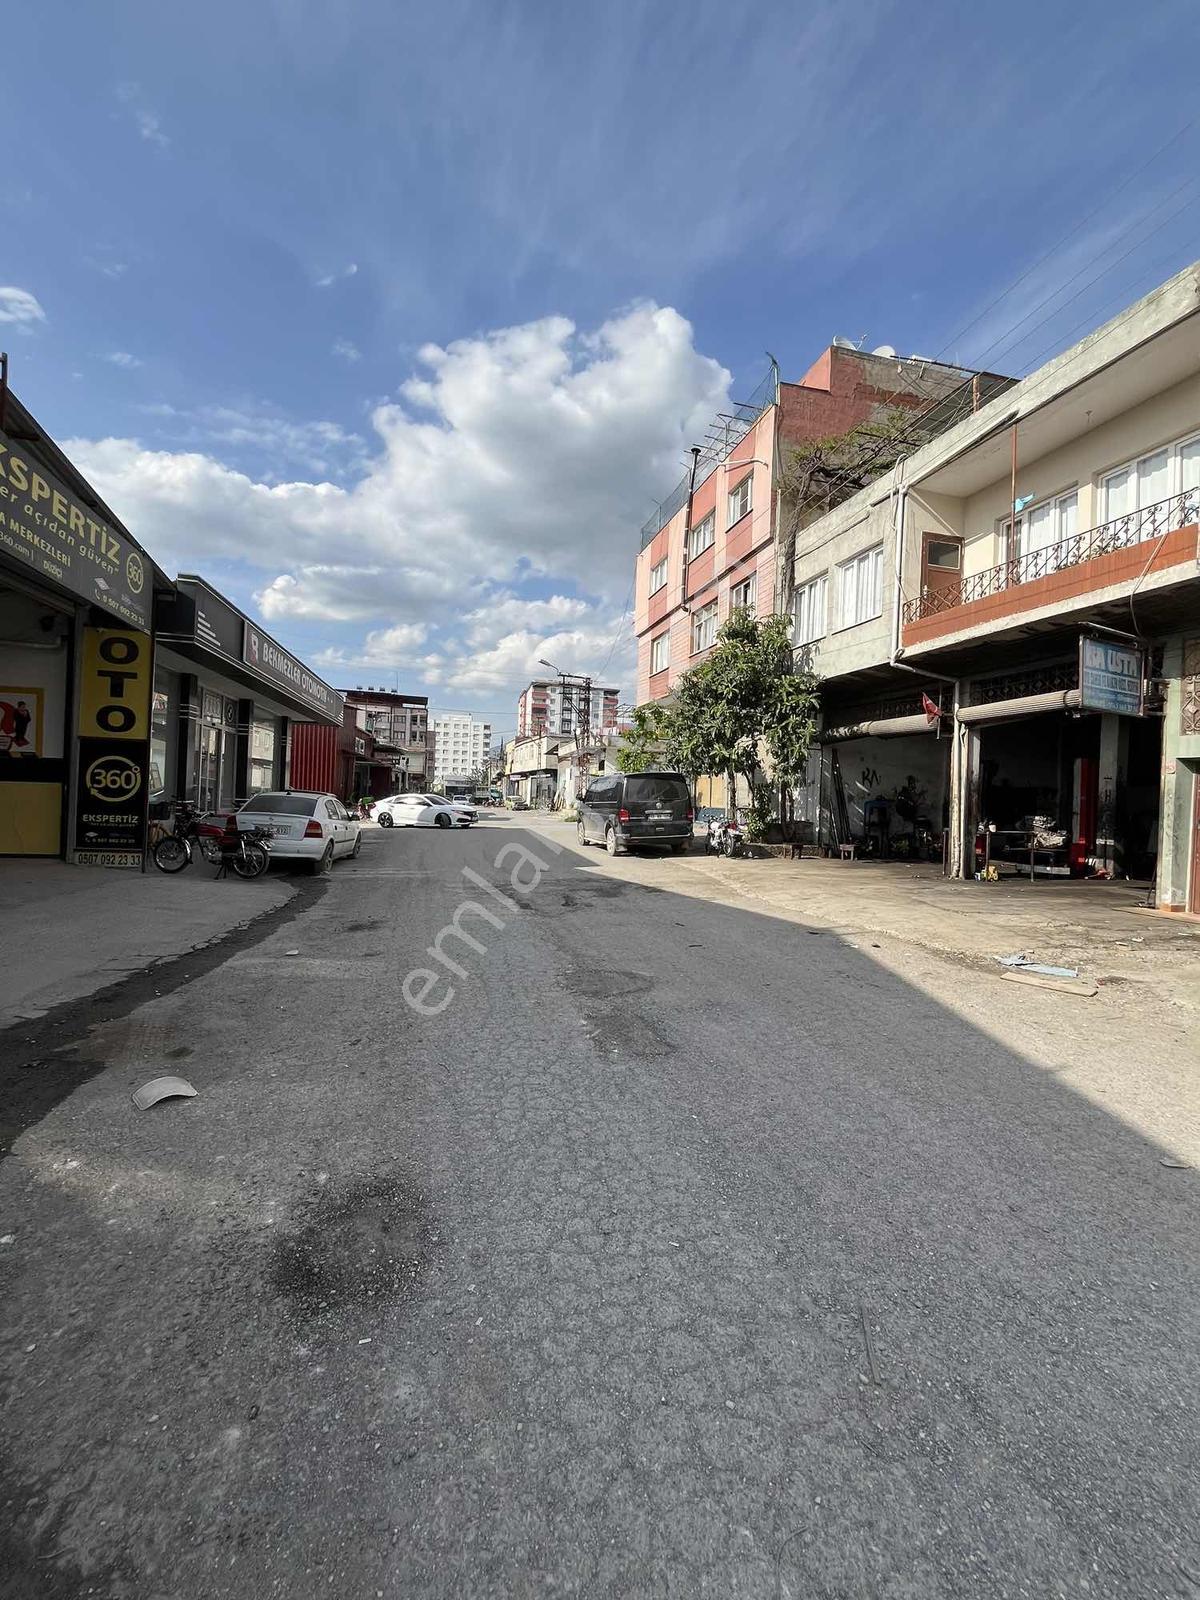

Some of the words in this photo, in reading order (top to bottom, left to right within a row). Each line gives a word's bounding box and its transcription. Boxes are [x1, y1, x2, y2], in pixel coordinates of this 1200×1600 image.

[10, 518, 71, 567] MERKEZLERİ
[24, 504, 75, 546] açıdan
[96, 637, 139, 733] OTO
[82, 814, 139, 823] EKSPERTİZ
[78, 853, 98, 865] 0507
[100, 854, 116, 866] 092
[117, 855, 128, 867] 23
[130, 855, 141, 867] 33
